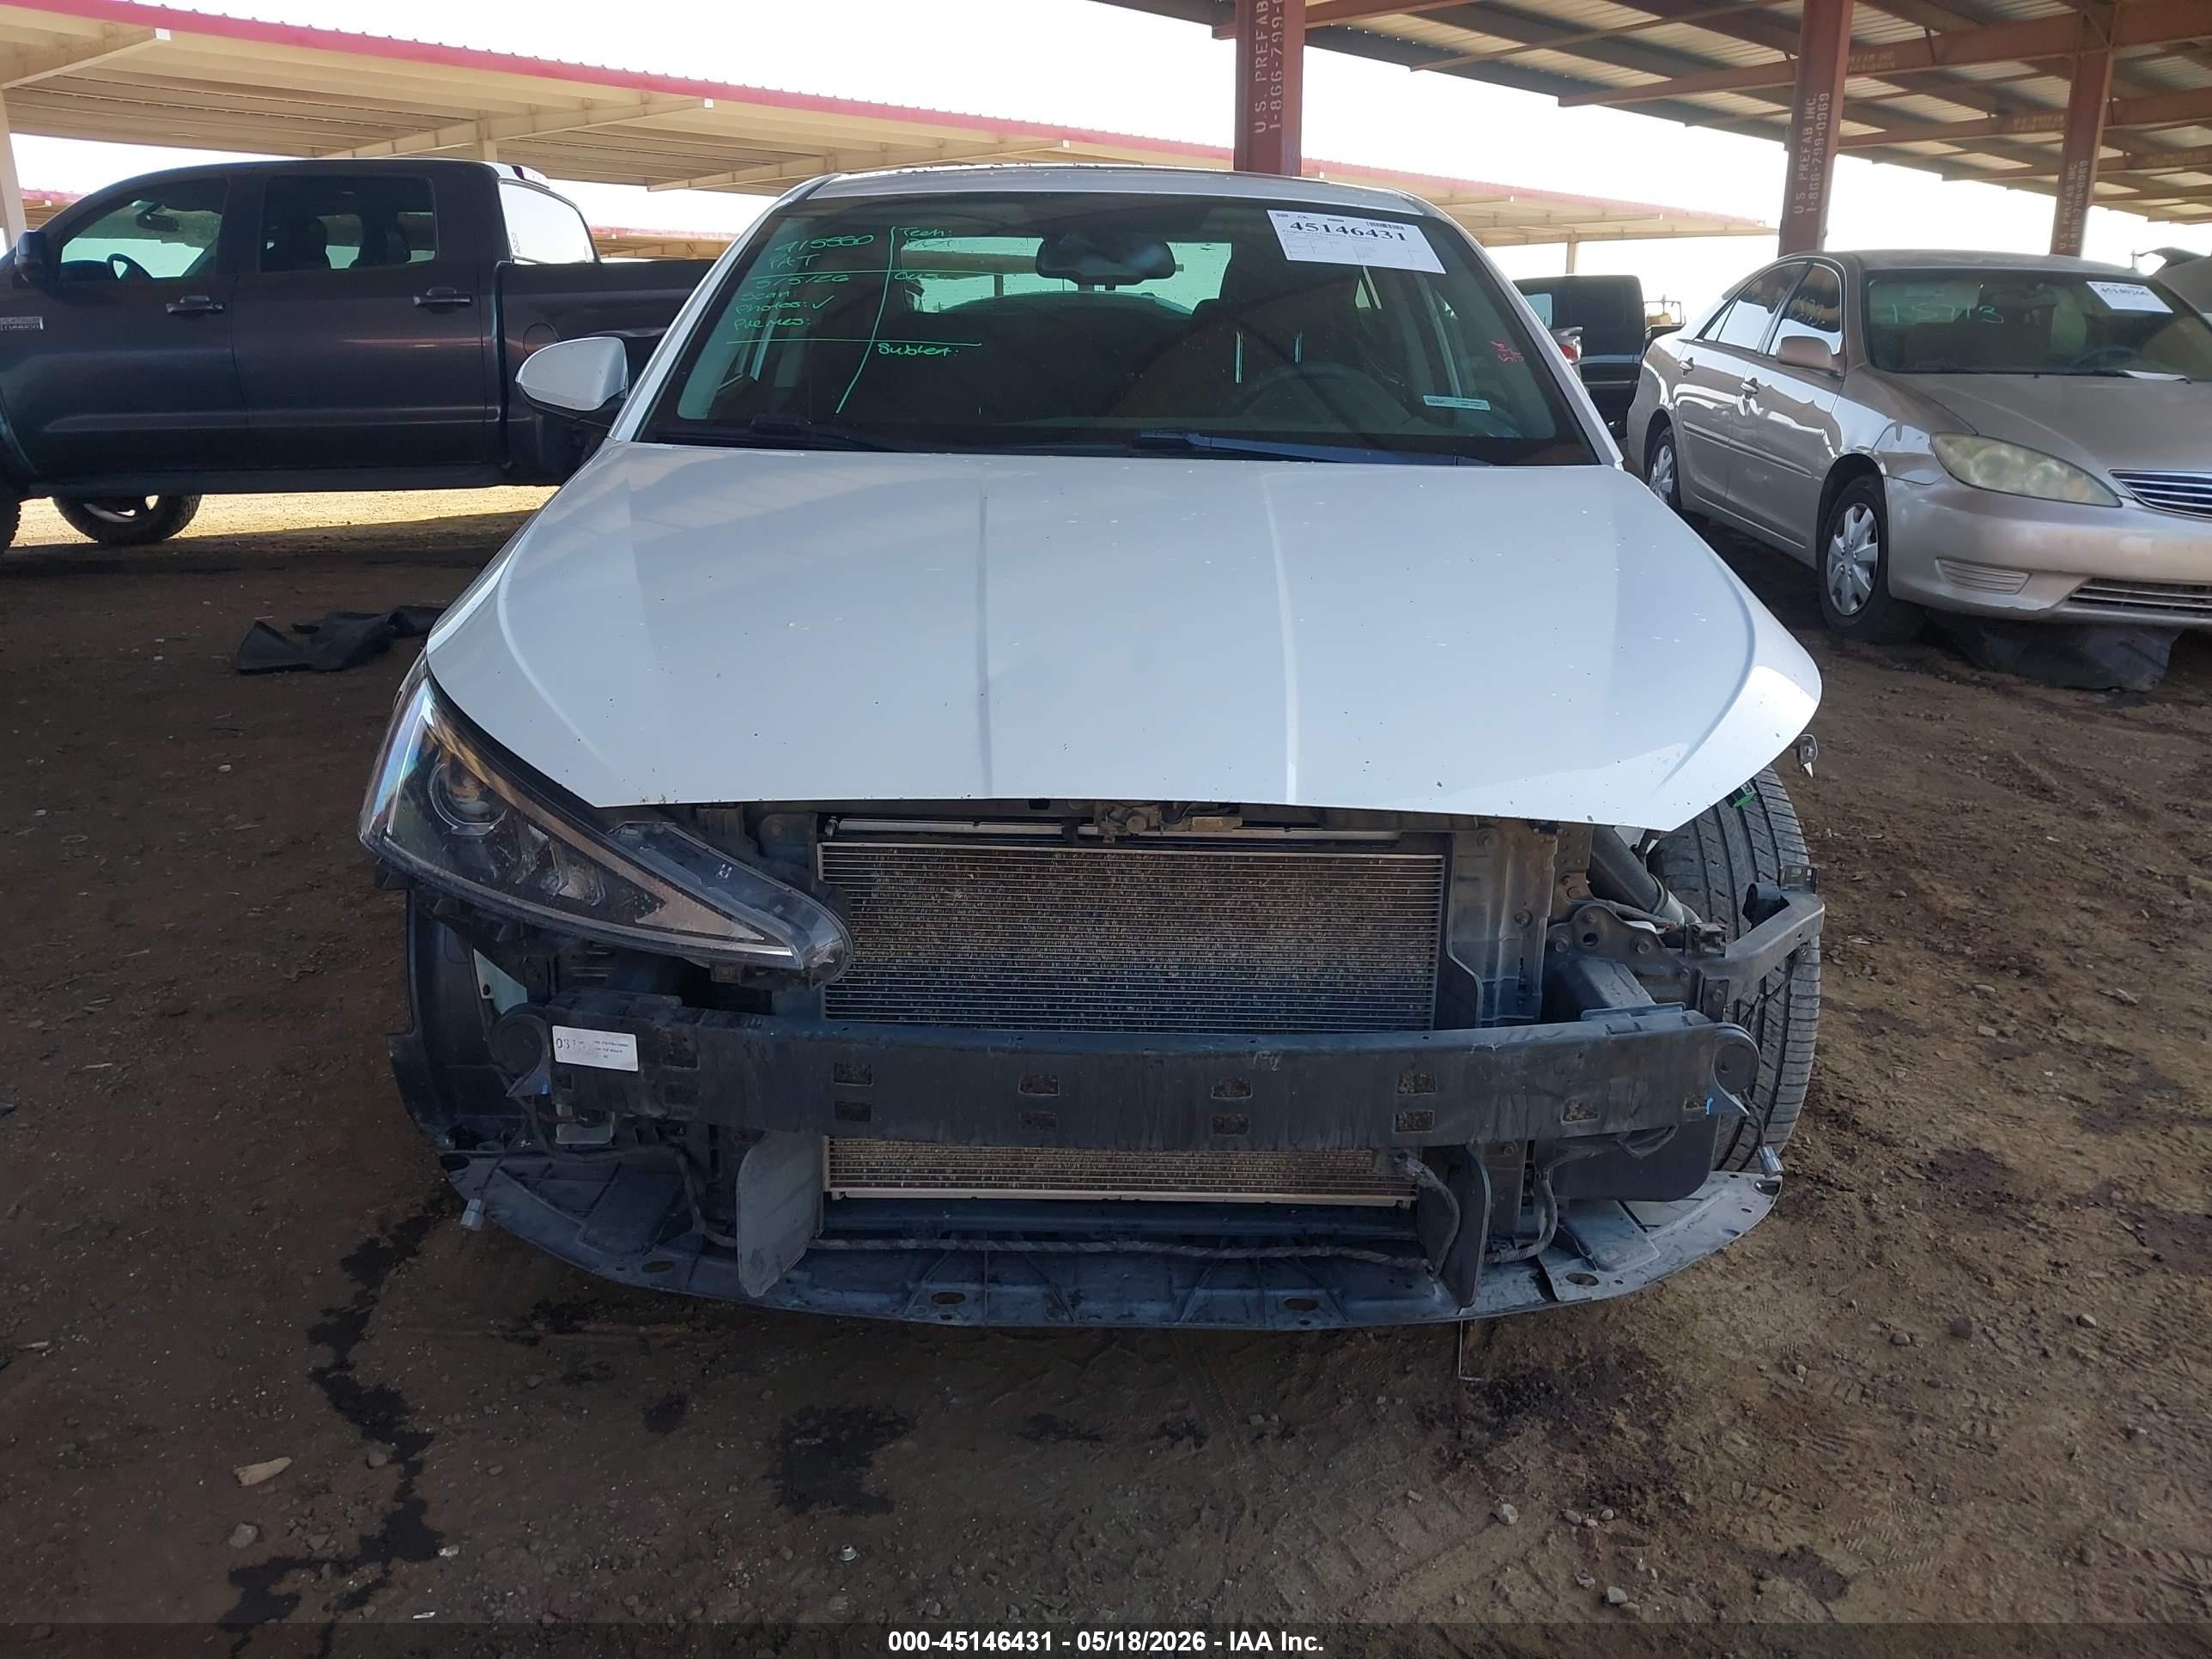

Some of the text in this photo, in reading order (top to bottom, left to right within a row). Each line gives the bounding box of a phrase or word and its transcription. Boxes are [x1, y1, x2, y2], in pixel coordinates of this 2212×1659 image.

[1255, 1, 1268, 82] PREFAB
[1799, 126, 1813, 180] PREFAB
[1806, 92, 1830, 212] 1-866-799-0969
[1290, 222, 1407, 241] 45146431
